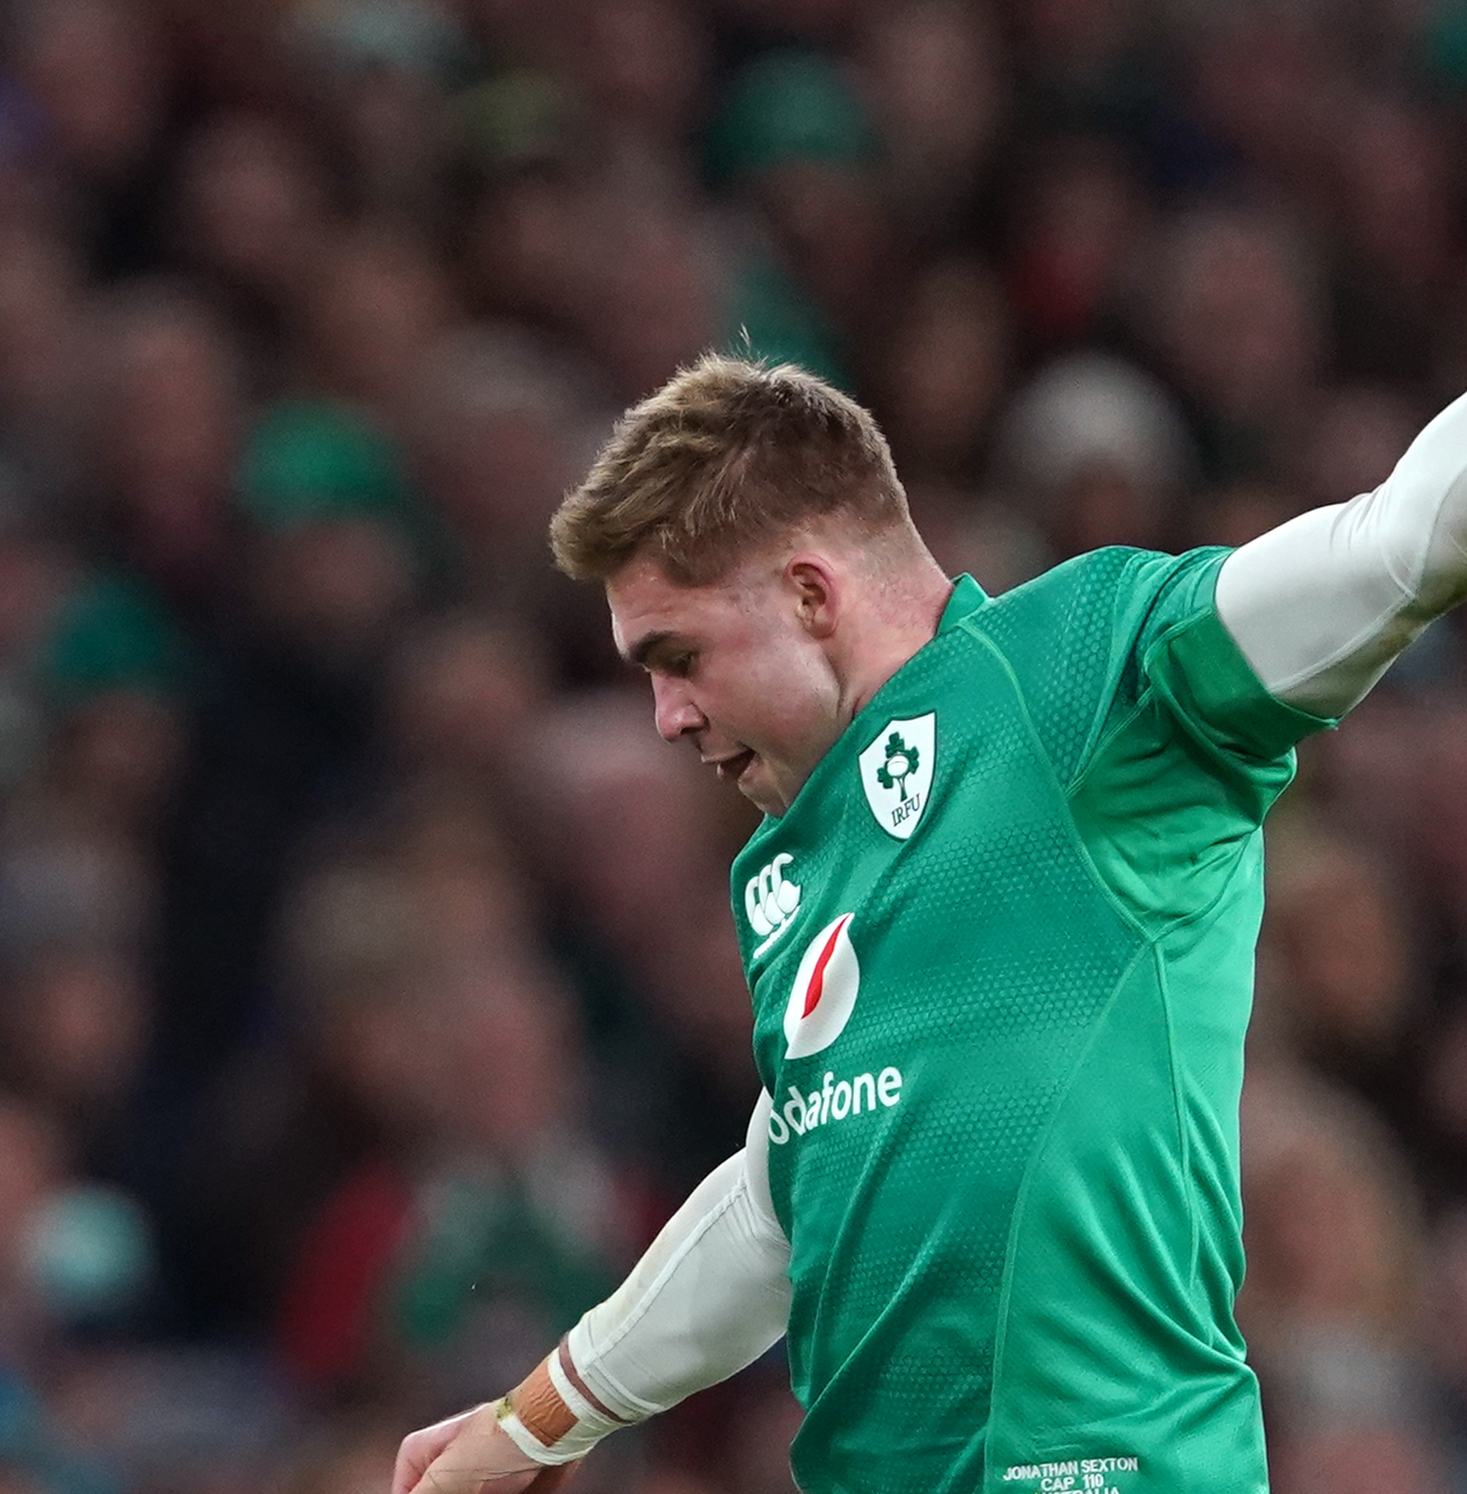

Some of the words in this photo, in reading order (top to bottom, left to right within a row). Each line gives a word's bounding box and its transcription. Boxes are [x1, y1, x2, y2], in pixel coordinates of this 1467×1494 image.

[891, 793, 920, 827] IRFU
[1003, 1461, 1079, 1481] JONATHAN
[1080, 1457, 1138, 1473] SEXTON
[1040, 1477, 1075, 1492] CAP
[1082, 1474, 1104, 1489] 110
